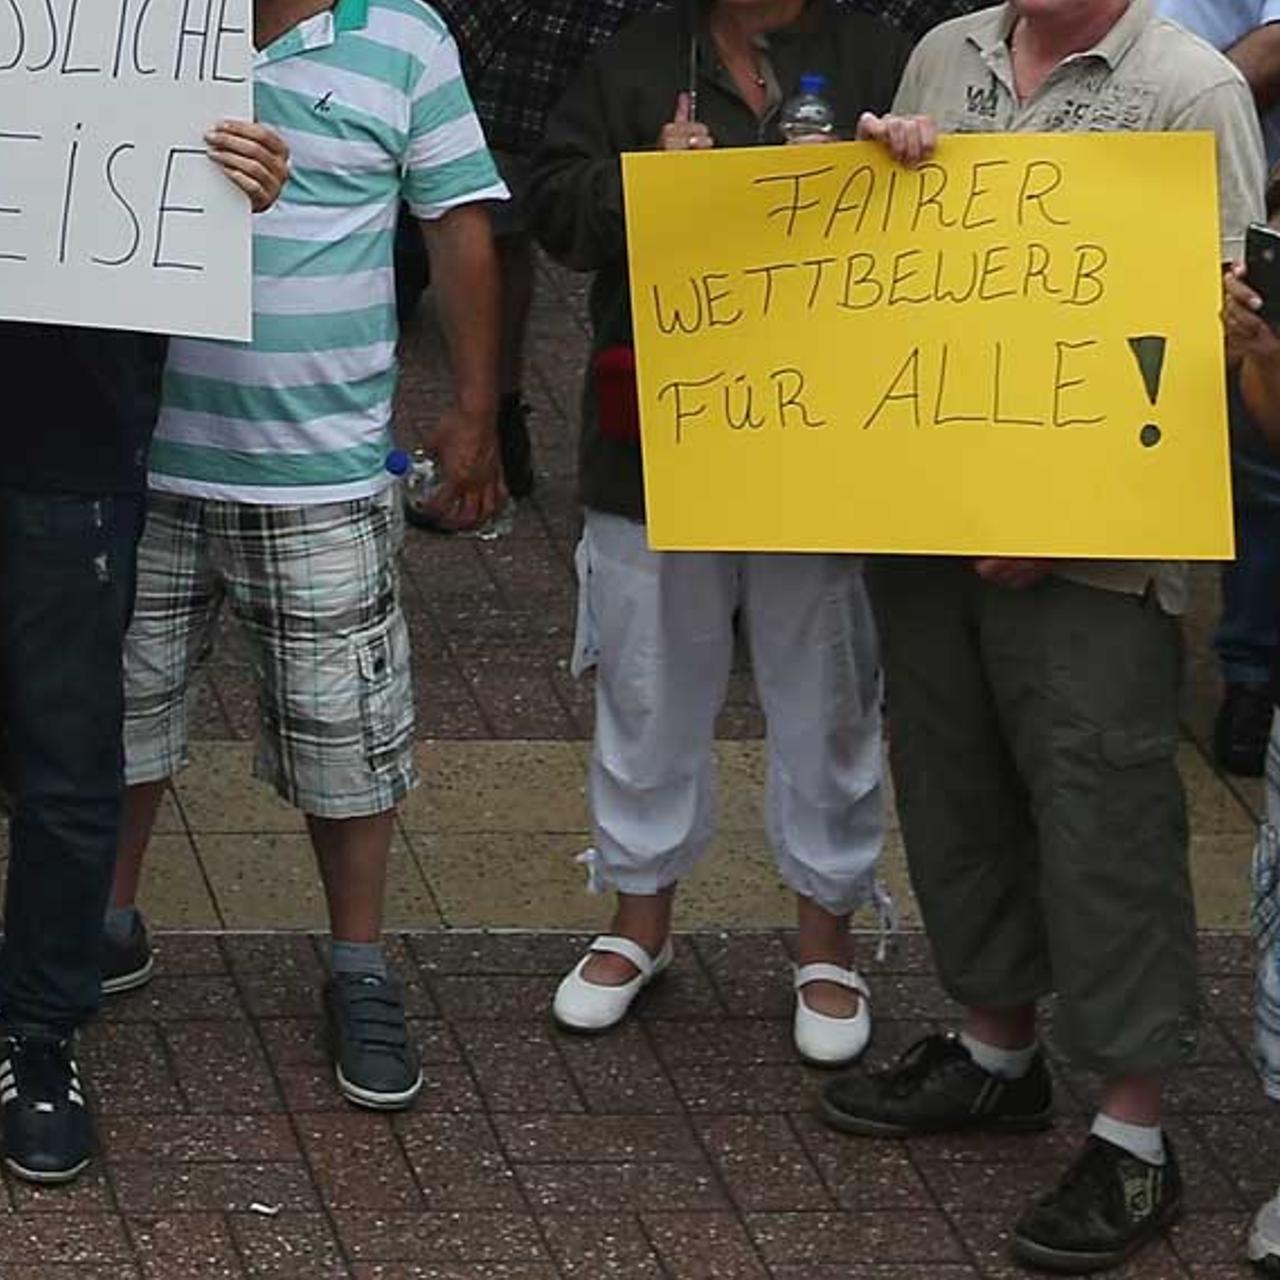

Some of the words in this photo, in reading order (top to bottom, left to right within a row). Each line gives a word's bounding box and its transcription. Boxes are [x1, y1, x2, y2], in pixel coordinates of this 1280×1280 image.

[753, 160, 1071, 238] FAIRER
[653, 243, 1108, 335] WETTBEWERB
[656, 368, 827, 444] FÜR
